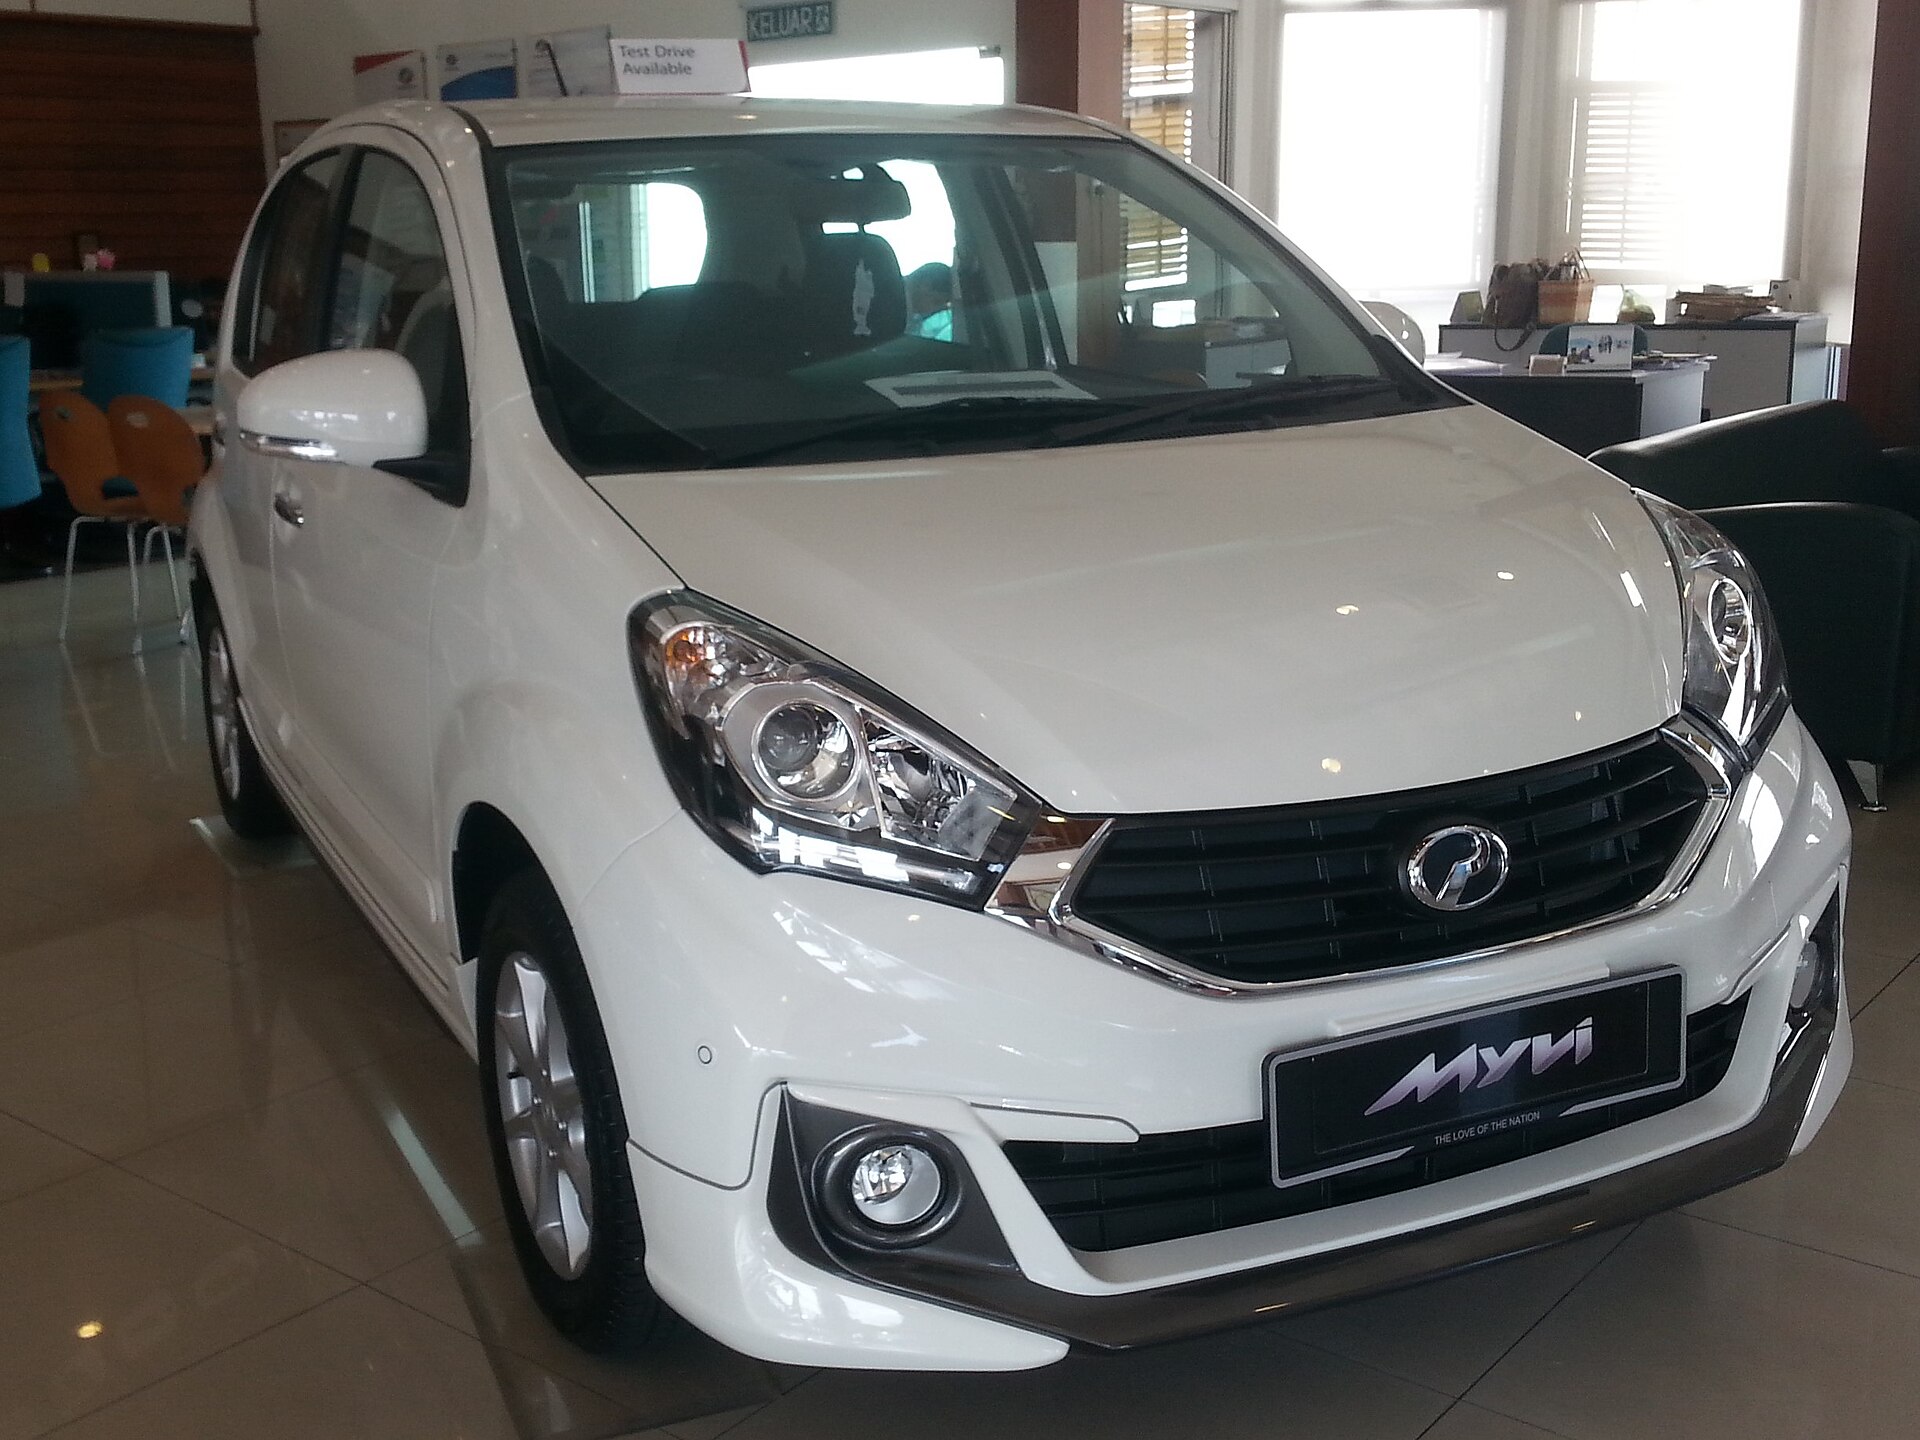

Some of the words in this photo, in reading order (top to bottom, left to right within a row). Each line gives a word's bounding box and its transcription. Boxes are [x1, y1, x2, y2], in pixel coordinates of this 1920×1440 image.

[749, 7, 813, 38] KELUAR
[619, 45, 650, 57] Test
[654, 45, 695, 58] Drive
[623, 61, 692, 75] Available
[1434, 1133, 1452, 1145] THE
[1453, 1127, 1476, 1141] LOVE
[1476, 1123, 1490, 1135] OF
[1490, 1119, 1508, 1131] THE
[1508, 1111, 1540, 1125] NATION
